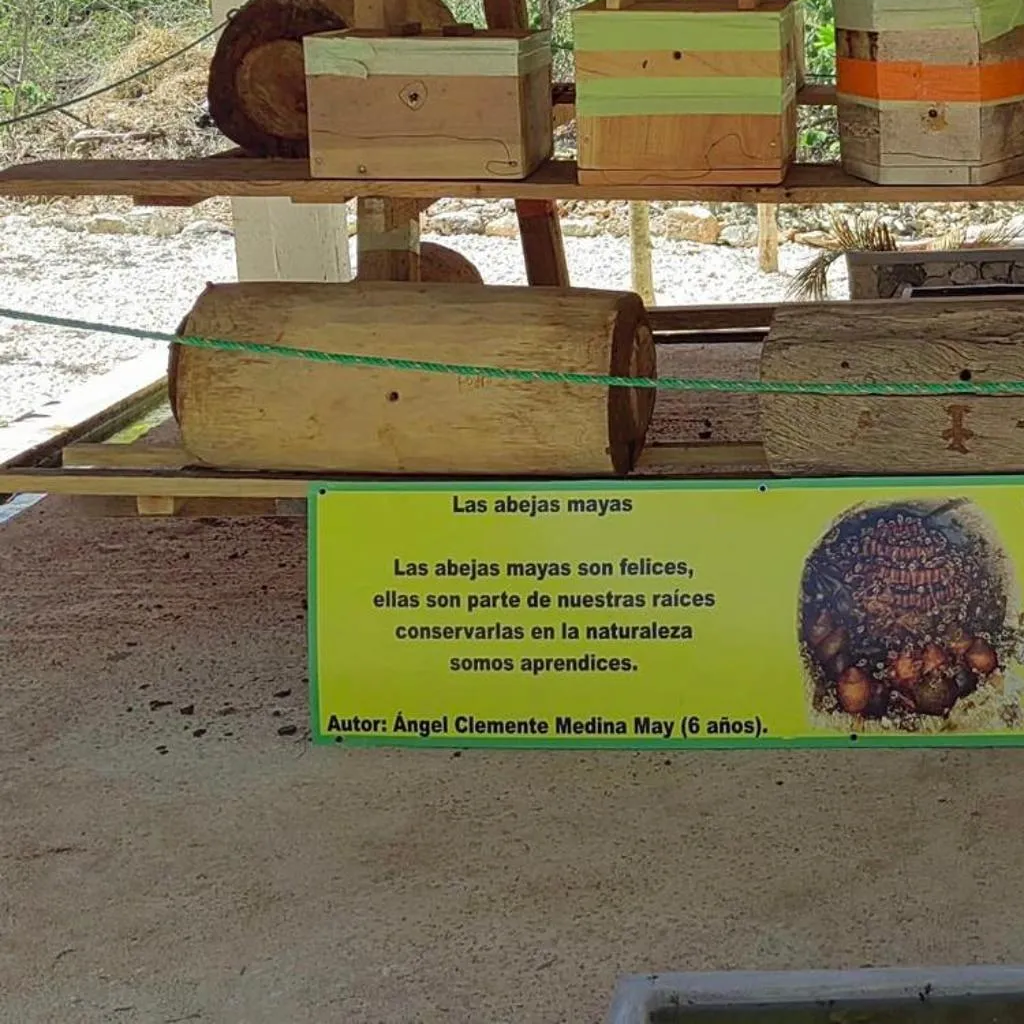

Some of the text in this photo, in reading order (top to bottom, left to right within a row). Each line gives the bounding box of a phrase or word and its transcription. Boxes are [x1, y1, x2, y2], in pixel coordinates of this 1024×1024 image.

[453, 495, 633, 517] Las abejas mayas
[394, 558, 694, 580] Las abejas mayas son felices,
[373, 590, 715, 613] ellas son parte de nuestras raíces
[395, 622, 693, 640] conservarlas en la naturaleza
[450, 654, 638, 675] somos aprendices.
[327, 712, 768, 739] Autor: Ángel Clemente Medina May (6 años).
